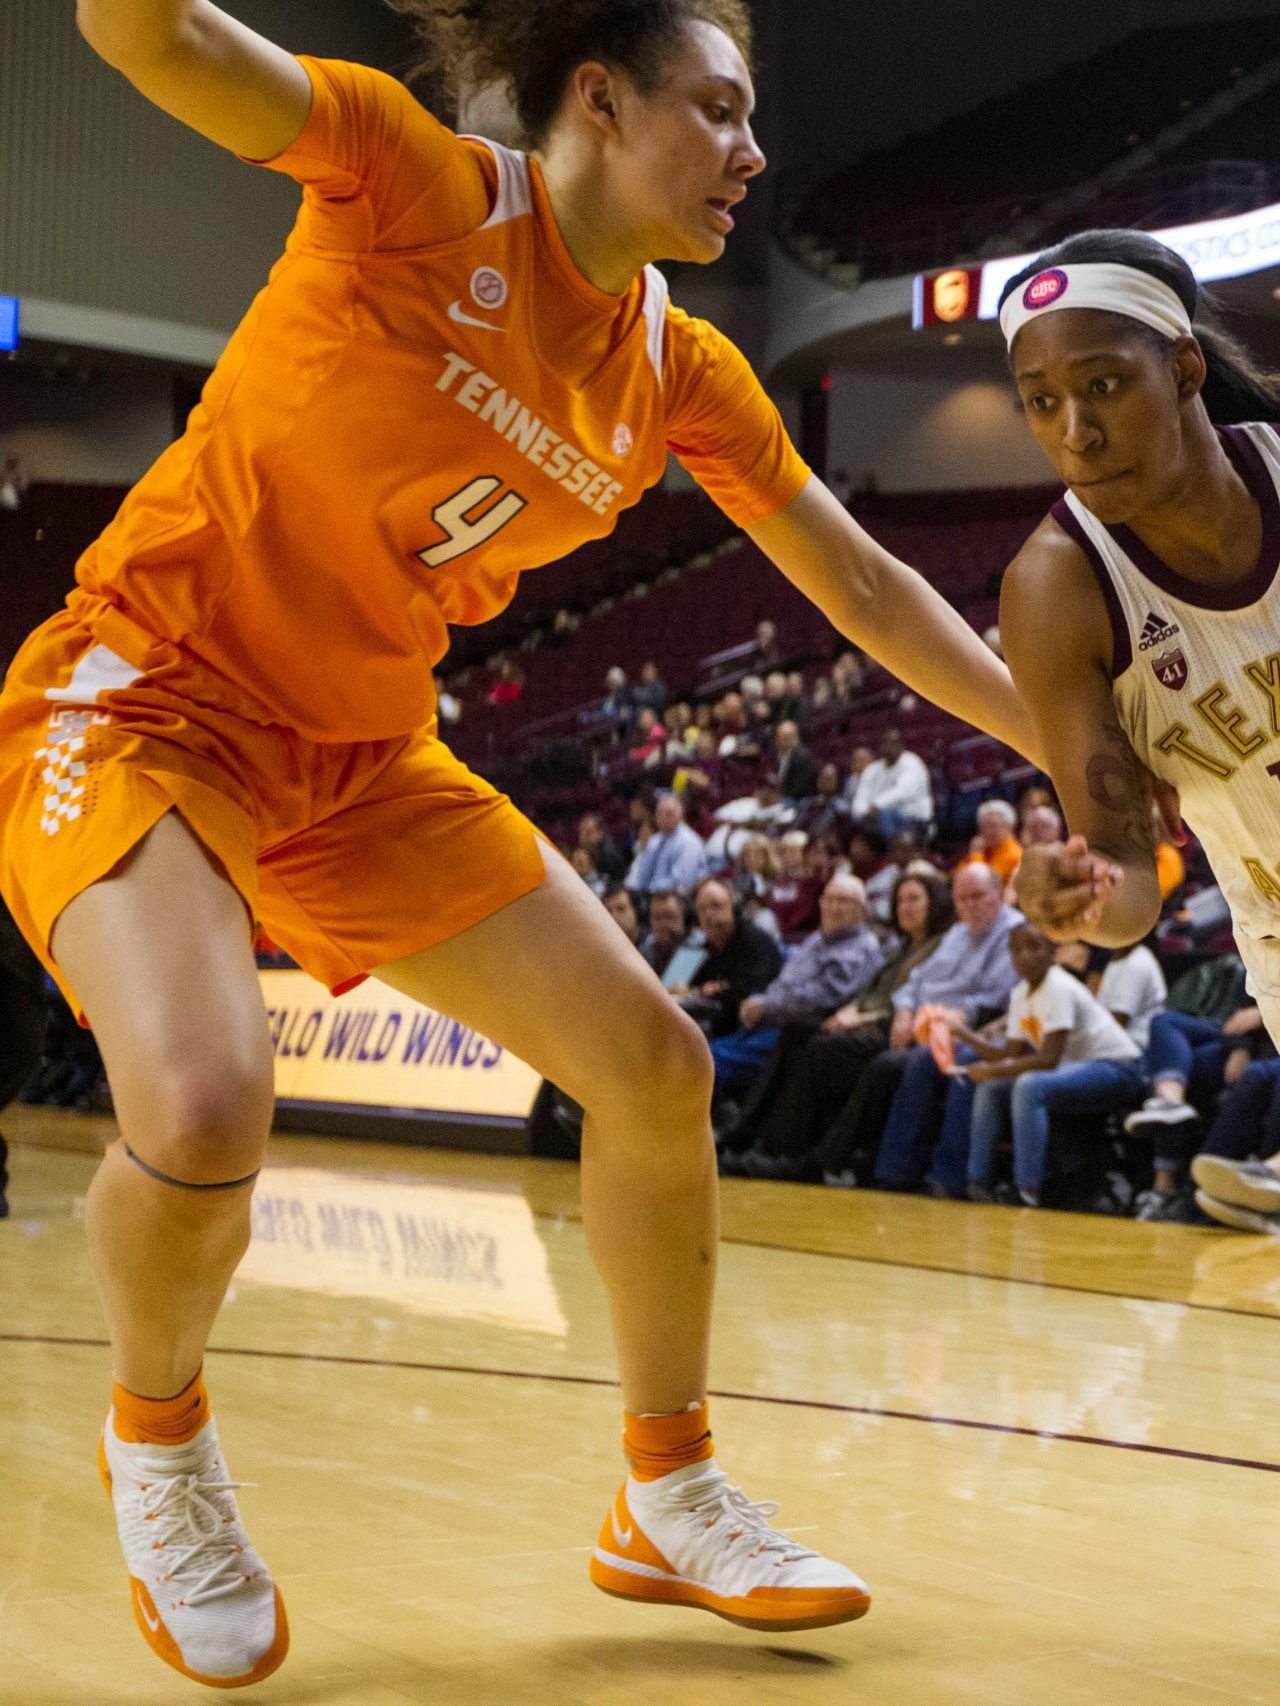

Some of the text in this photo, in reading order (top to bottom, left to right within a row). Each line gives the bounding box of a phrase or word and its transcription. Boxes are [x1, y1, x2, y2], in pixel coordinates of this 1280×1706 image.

[435, 351, 624, 516] TENNESSEE
[416, 475, 528, 569] 4
[1138, 623, 1180, 651] adidas
[1162, 662, 1184, 683] 41
[323, 1010, 402, 1062] WILD
[402, 1011, 503, 1069] WINGS
